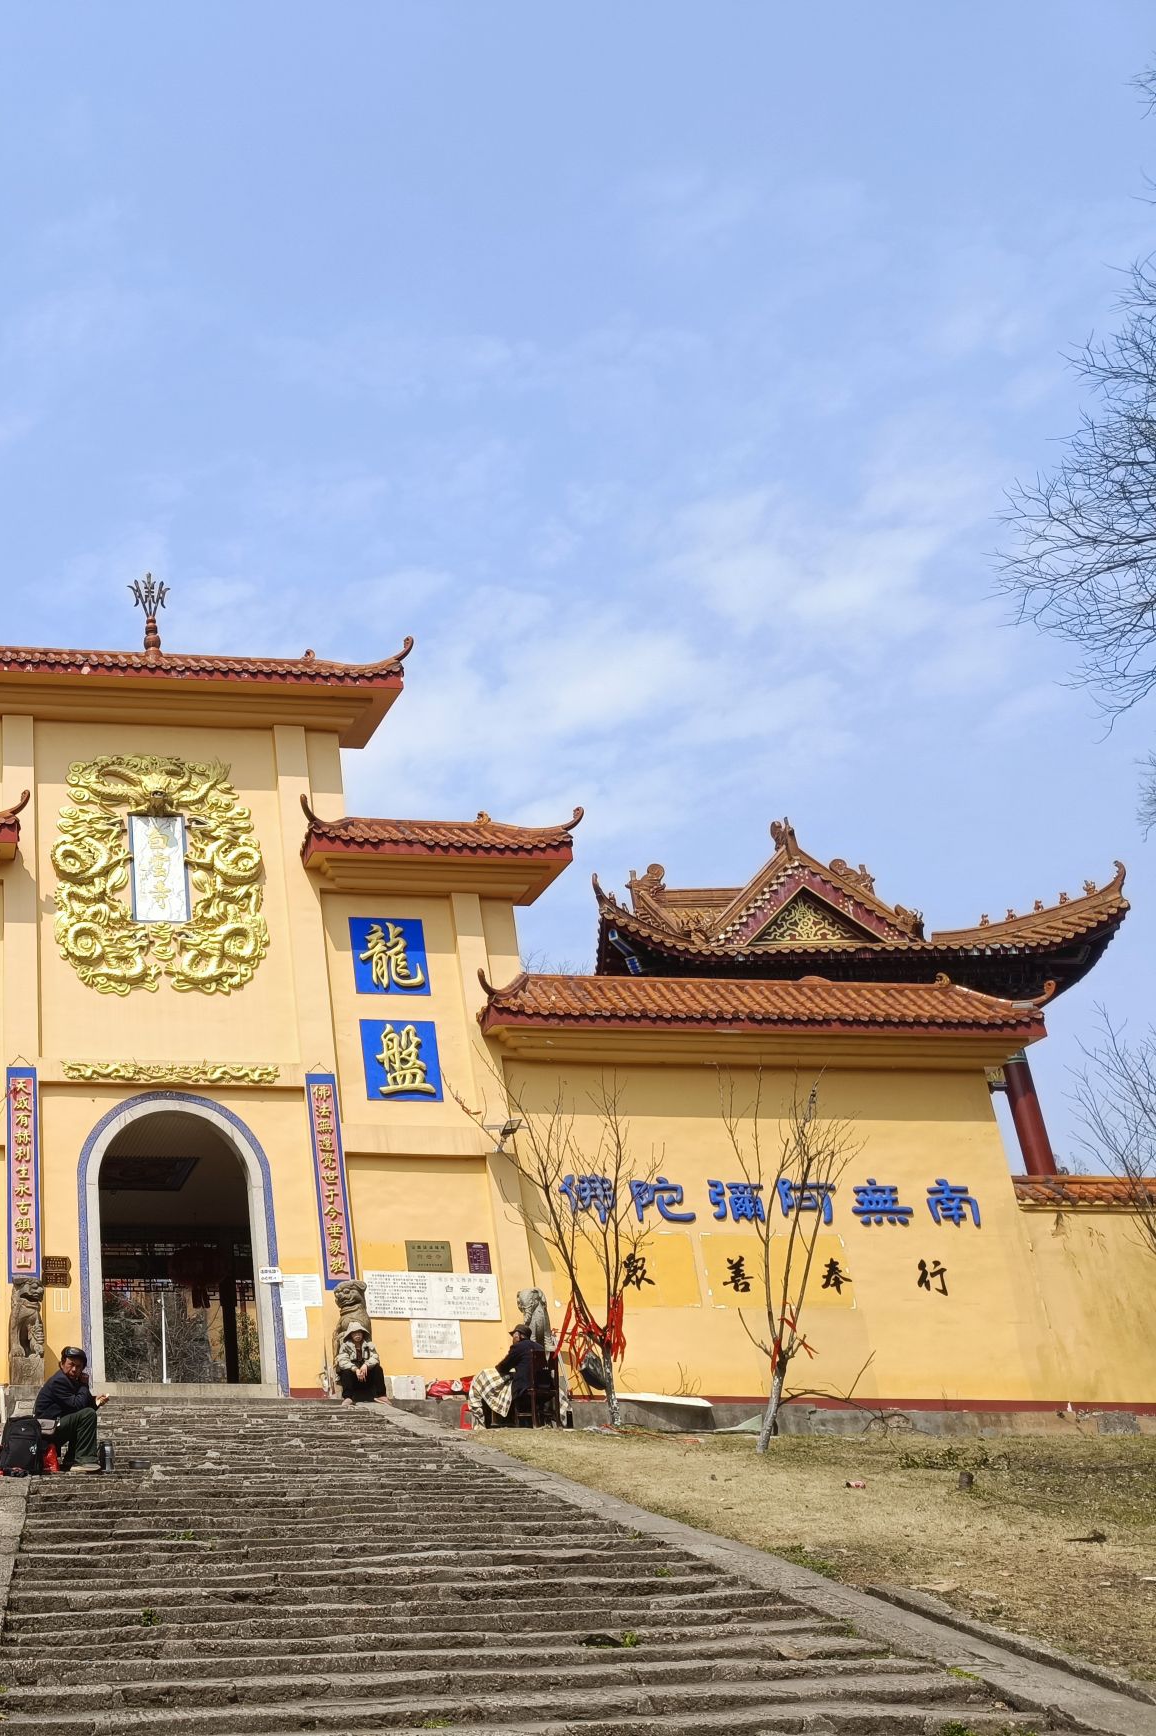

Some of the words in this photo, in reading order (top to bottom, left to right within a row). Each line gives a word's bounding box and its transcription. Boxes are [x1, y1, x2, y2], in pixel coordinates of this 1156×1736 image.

[359, 921, 437, 1095] 龍盤
[444, 1284, 487, 1294] 白云寺
